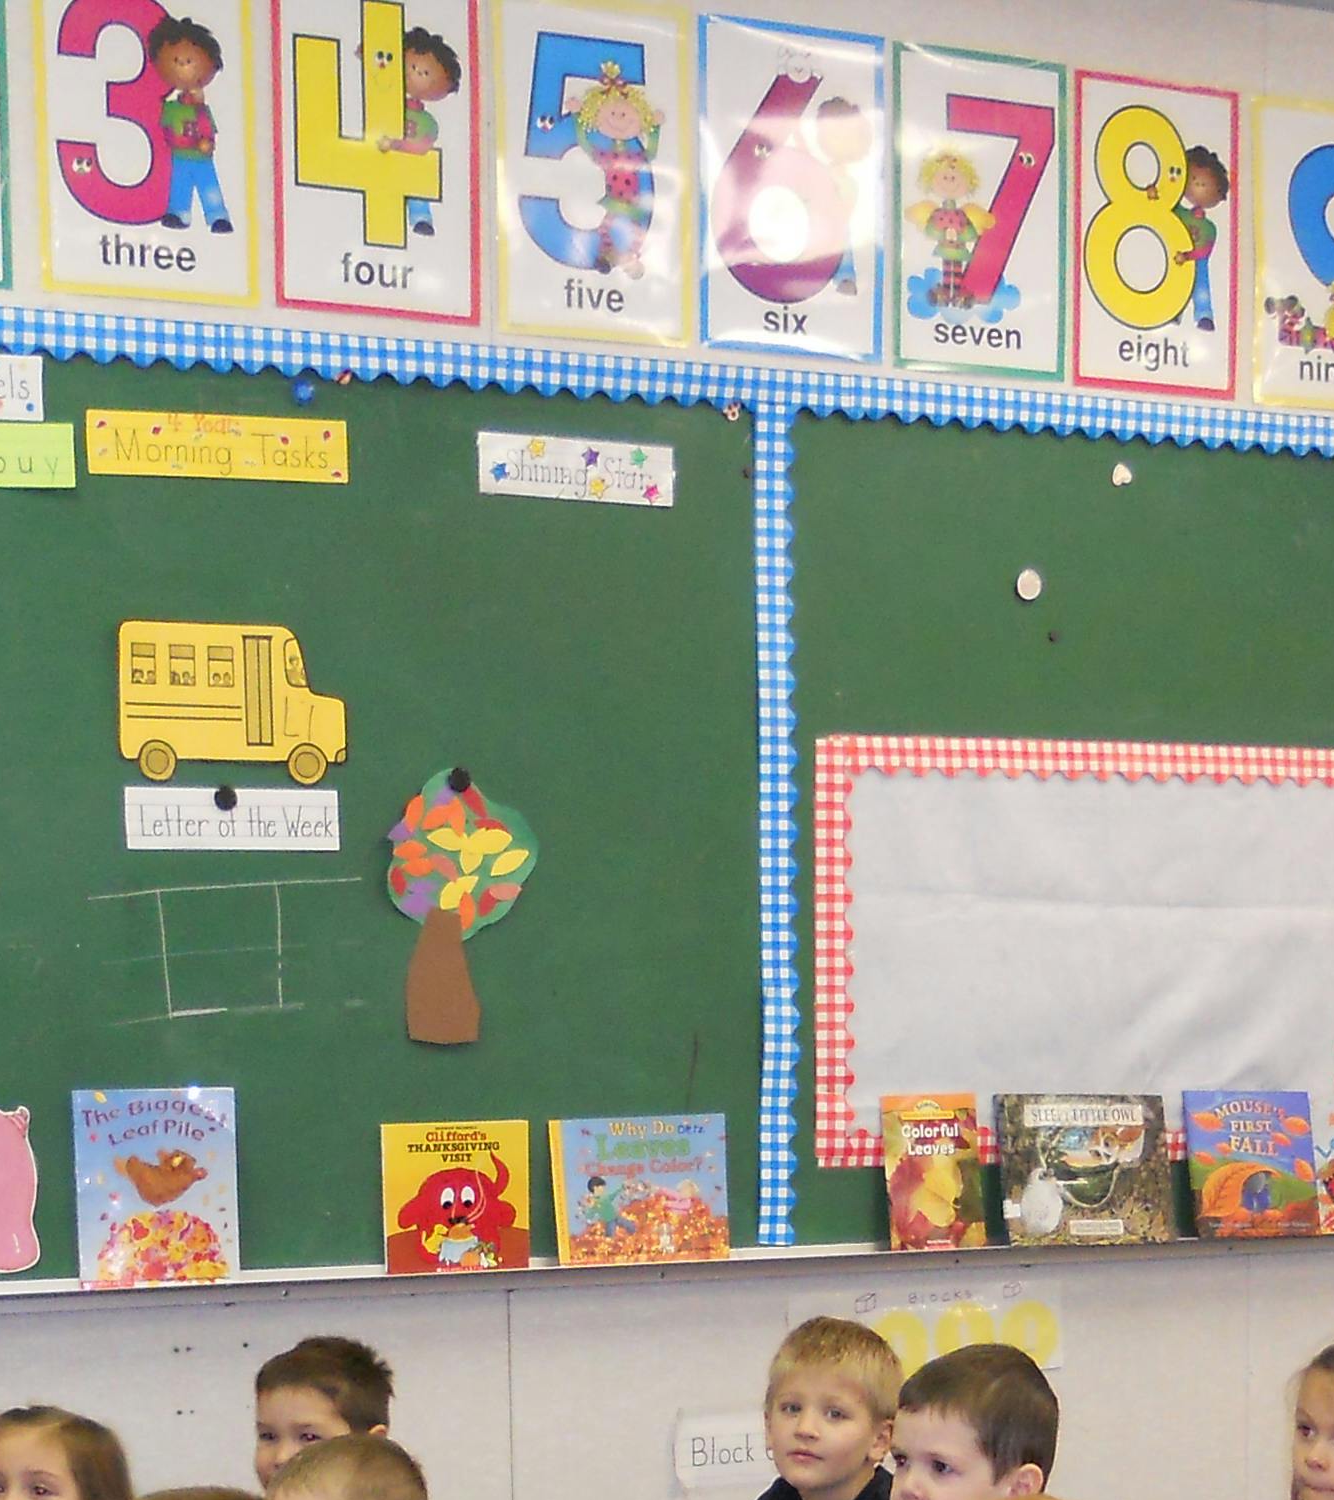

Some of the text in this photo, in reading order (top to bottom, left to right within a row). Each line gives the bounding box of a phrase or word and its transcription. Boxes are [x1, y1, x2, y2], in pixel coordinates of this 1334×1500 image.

[57, 0, 175, 226] 3
[292, 1, 442, 249] 4
[518, 32, 655, 275] 5
[713, 72, 845, 304] 6
[945, 93, 1055, 306] 7
[1084, 105, 1198, 328] 8
[99, 233, 197, 273] three
[341, 253, 414, 290] four
[563, 278, 625, 313] five
[763, 308, 808, 339] six
[934, 321, 1022, 351] seven
[1118, 334, 1190, 372] eight
[114, 429, 329, 477] Morning Tasks
[507, 449, 653, 498] Shining Star
[140, 804, 334, 838] Letter of the Week
[81, 1098, 229, 1129] The Biggest
[609, 1119, 675, 1139] Why Do
[901, 1122, 960, 1138] Colorful
[1229, 1120, 1273, 1133] FIRST
[108, 1119, 206, 1146] Leaf Pile
[407, 1141, 500, 1153] THANKSGIVING
[425, 1131, 487, 1142] Clifford's
[907, 1142, 955, 1156] Leaves
[1228, 1135, 1279, 1156] FALL
[441, 1153, 473, 1162] VISIT
[692, 1434, 755, 1467] Block
